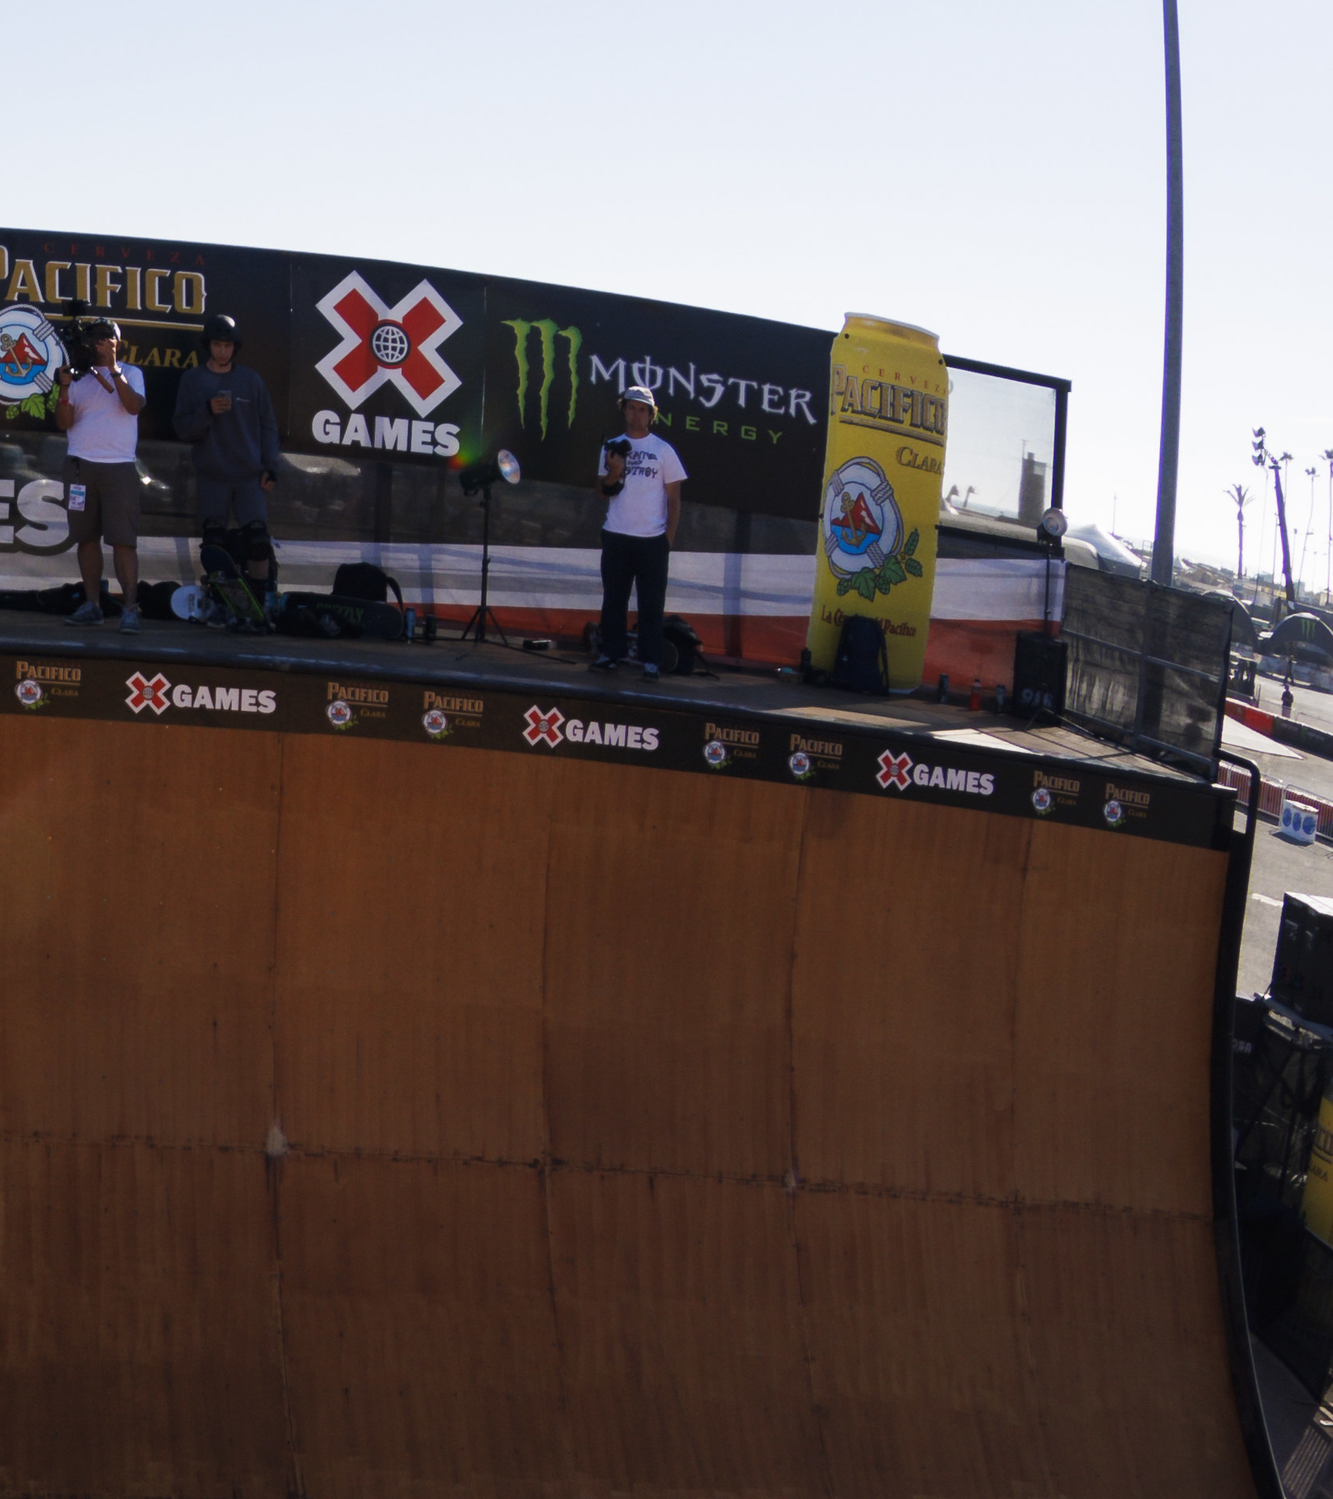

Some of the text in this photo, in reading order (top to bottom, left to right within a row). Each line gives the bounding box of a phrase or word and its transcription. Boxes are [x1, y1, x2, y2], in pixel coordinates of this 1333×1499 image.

[44, 242, 205, 266] CERVEZA
[589, 354, 817, 425] MONSTER
[311, 409, 461, 457] GAMES
[654, 412, 783, 444] NERGY
[16, 660, 82, 682] PACIFICO
[172, 684, 277, 714] GAMES
[327, 682, 389, 703] PACIFICO
[424, 691, 483, 713] PACIFICO
[565, 719, 659, 751] GAMES
[705, 722, 760, 745] PACIFICO
[790, 733, 843, 756] PACIFICO
[913, 763, 995, 796] GAMES
[1033, 770, 1080, 793] PACIFICO
[1105, 782, 1150, 805] PACIFICO
